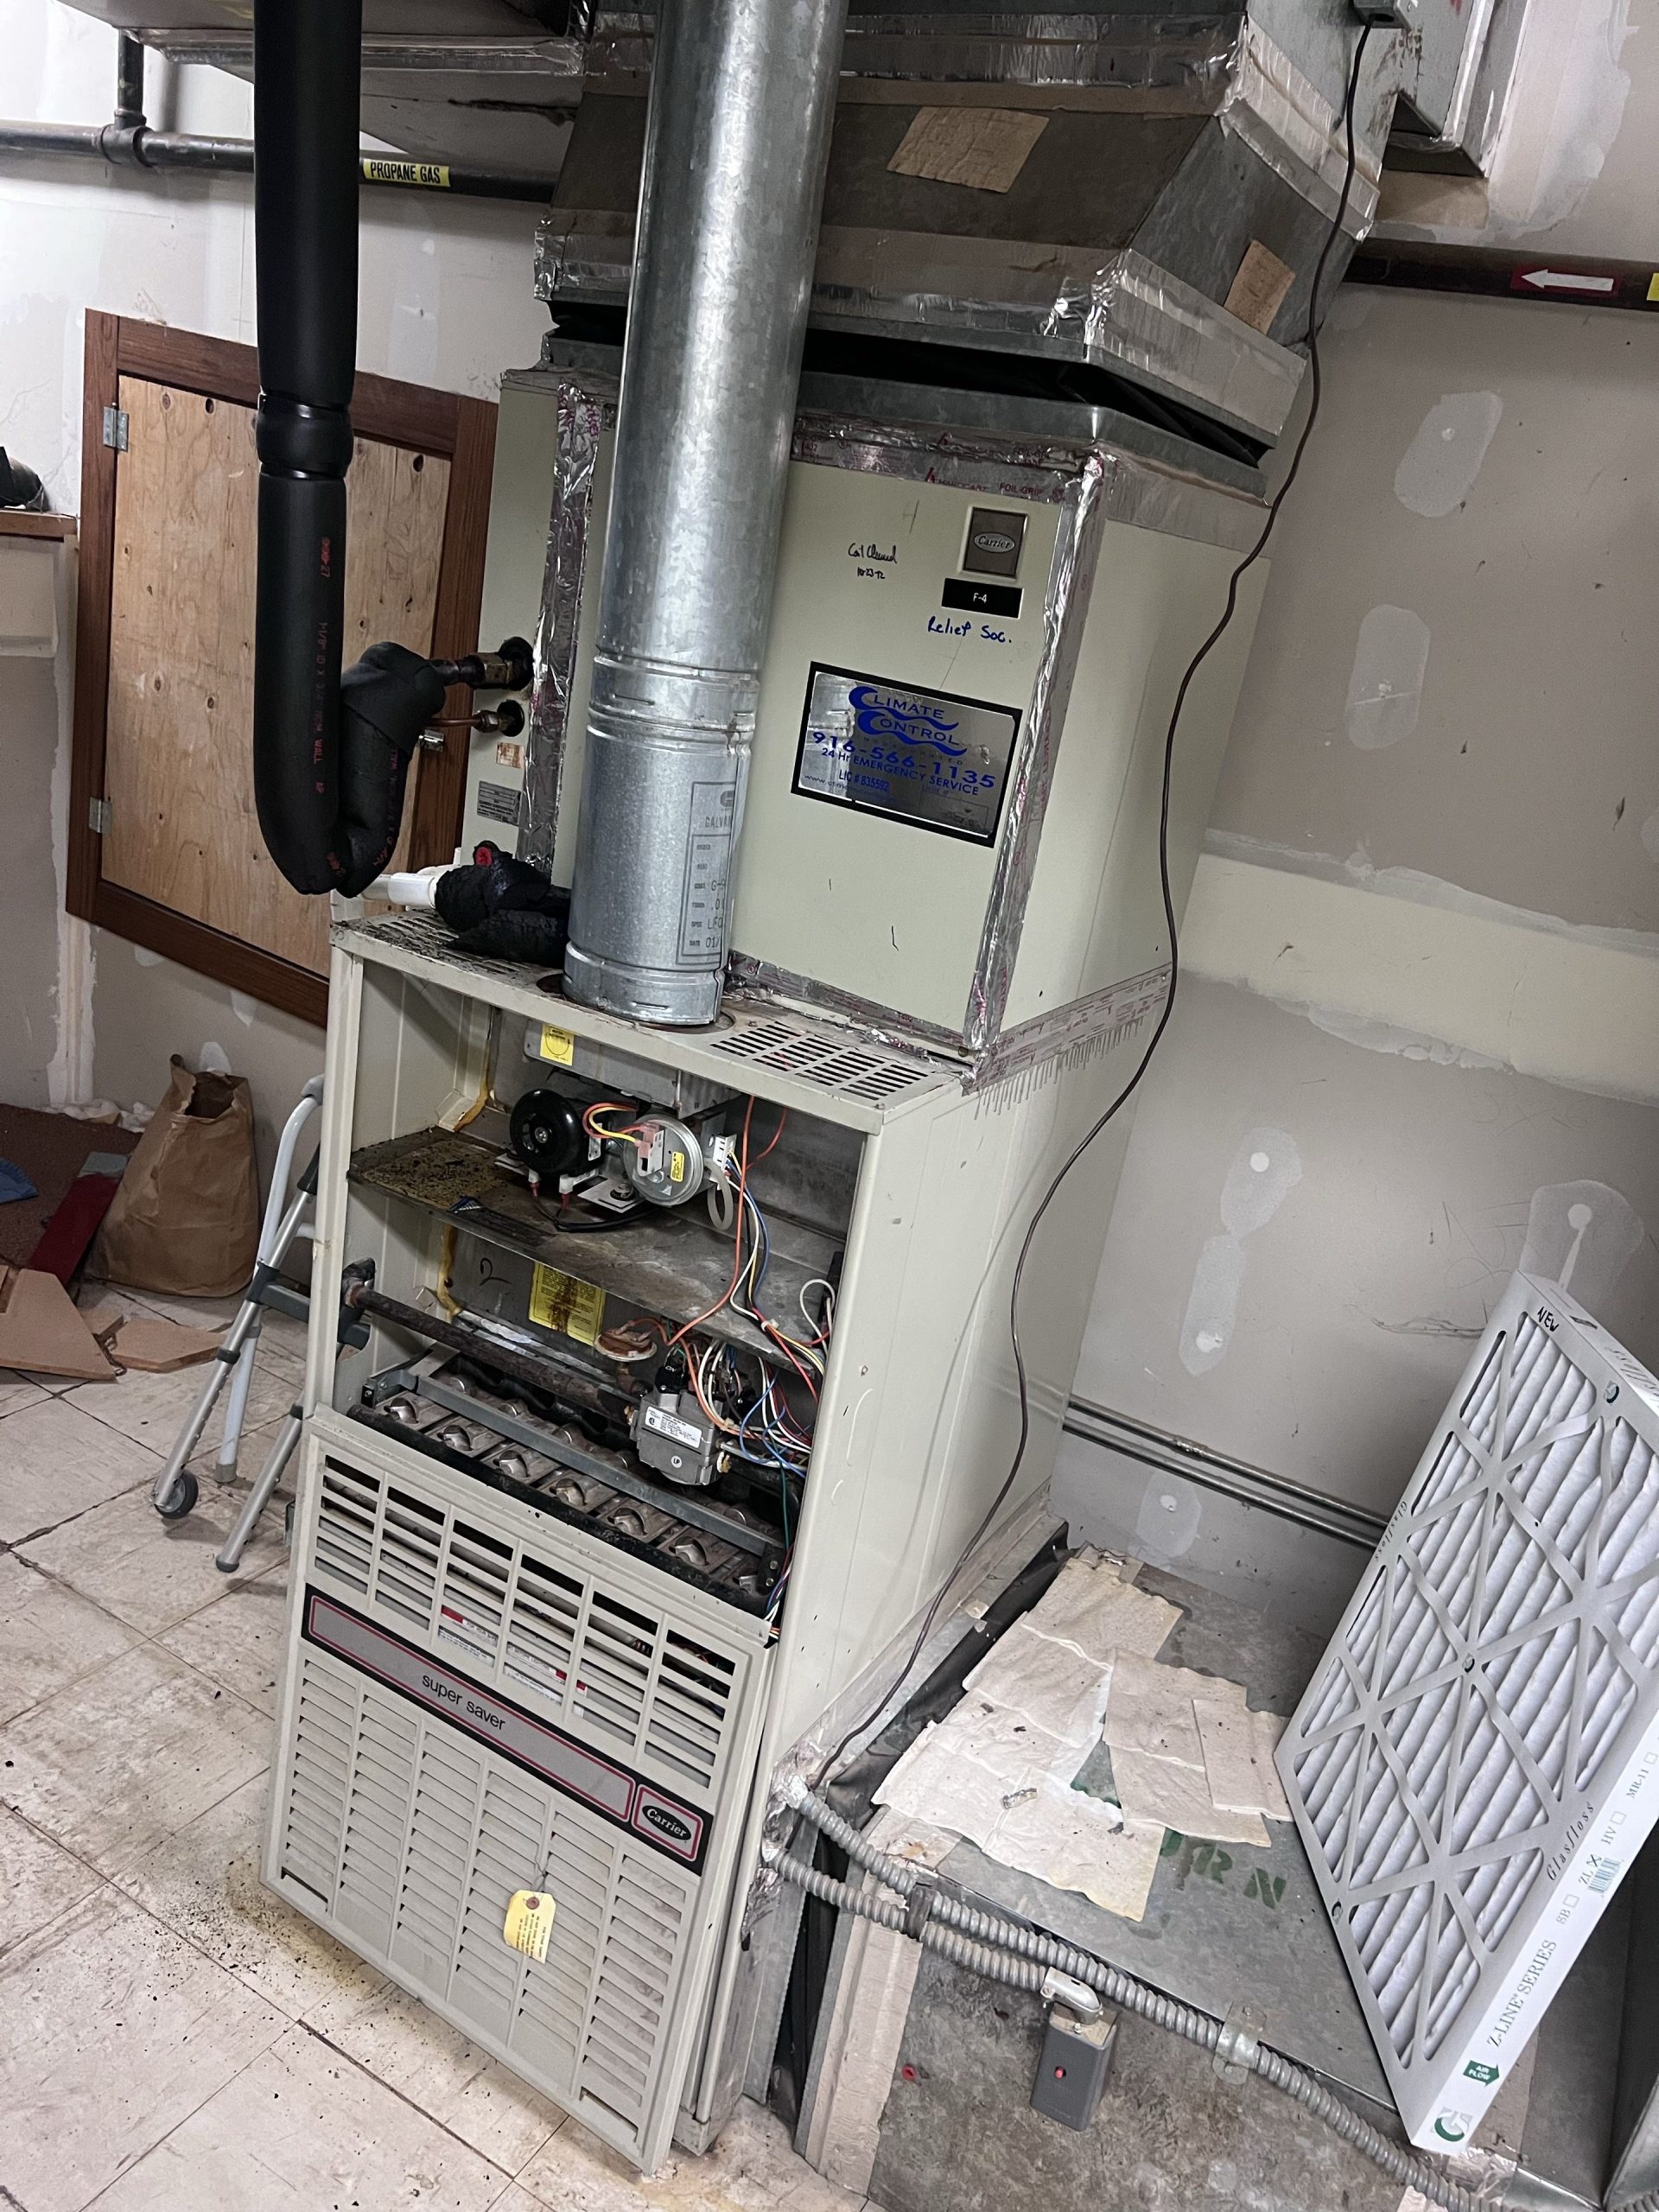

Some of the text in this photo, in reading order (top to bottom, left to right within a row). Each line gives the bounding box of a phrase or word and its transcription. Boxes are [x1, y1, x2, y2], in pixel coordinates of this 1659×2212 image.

[370, 162, 441, 184] PROPANE GAS
[977, 535, 1011, 549] Carrier
[973, 592, 988, 603] F-4
[927, 615, 1012, 643] Relief Soc.
[849, 685, 945, 721] CLIMATE
[857, 710, 961, 747] CONTROL
[812, 731, 996, 789] 916-566-1135
[821, 747, 835, 759] 24
[853, 754, 926, 782] EMERGENCY
[929, 774, 980, 796] SERVICE
[1537, 1306, 1560, 1332] NEW
[422, 1673, 506, 1731] super saver
[1626, 1768, 1649, 1799] MR-11
[646, 1808, 688, 1838] Carrier
[1600, 1826, 1618, 1846] HV
[1547, 1800, 1595, 1882] Glasfloss
[1578, 1870, 1594, 1886] ZL
[1555, 1908, 1572, 1925] SB
[1517, 1939, 1557, 1996] SERIES
